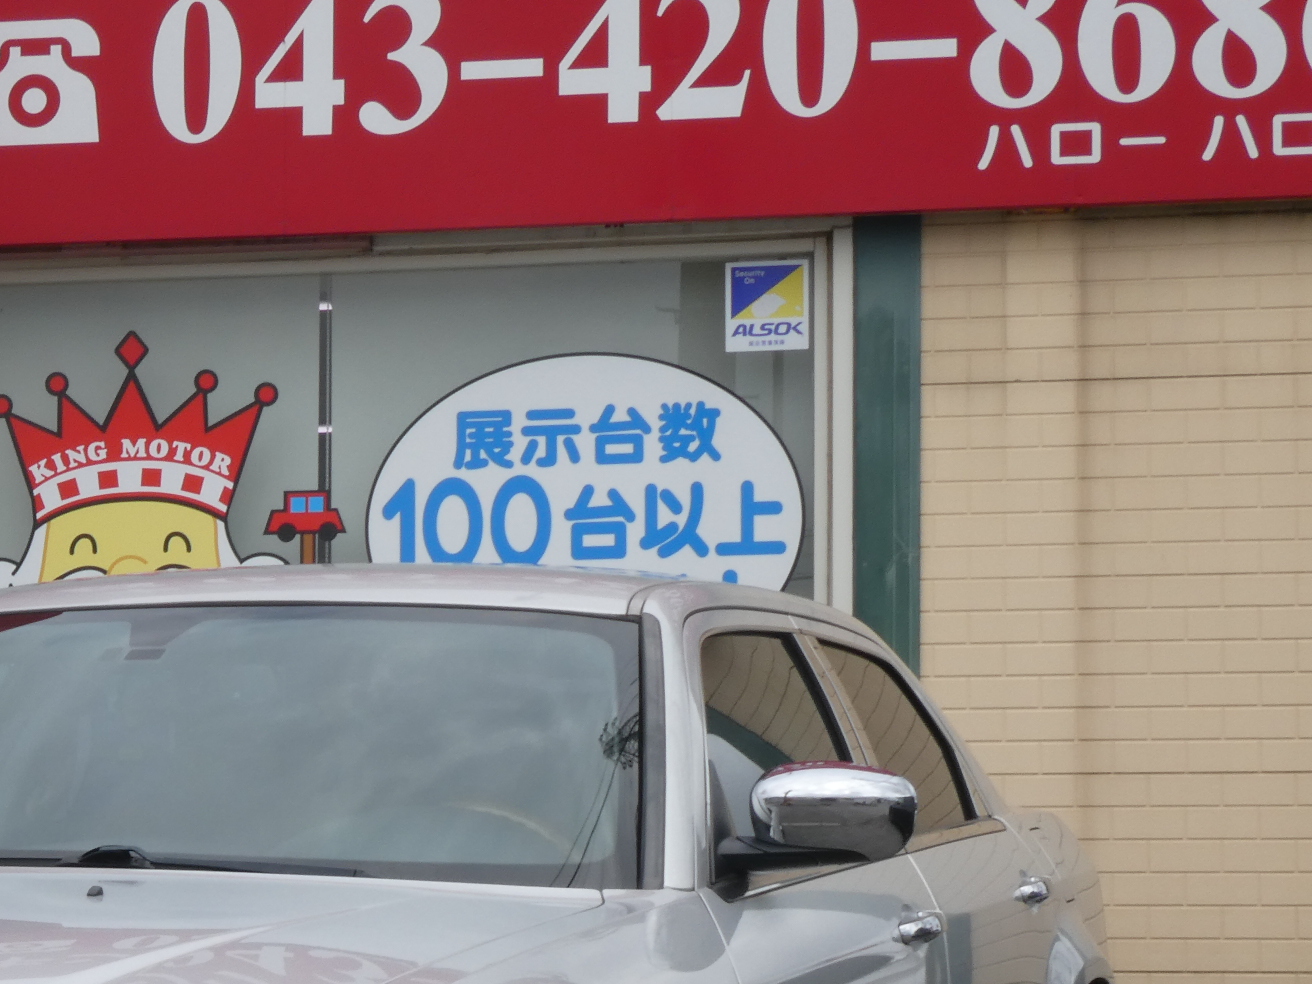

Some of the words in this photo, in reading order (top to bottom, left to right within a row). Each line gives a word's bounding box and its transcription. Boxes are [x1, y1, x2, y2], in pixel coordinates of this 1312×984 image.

[152, 0, 1312, 143] 043-420-868
[977, 121, 1167, 170] ハロー
[731, 321, 803, 337] ALSOK
[28, 441, 108, 484] KING
[120, 438, 232, 476] MOTOR
[453, 400, 722, 470] 展示台数
[382, 474, 787, 566] 100台以上
